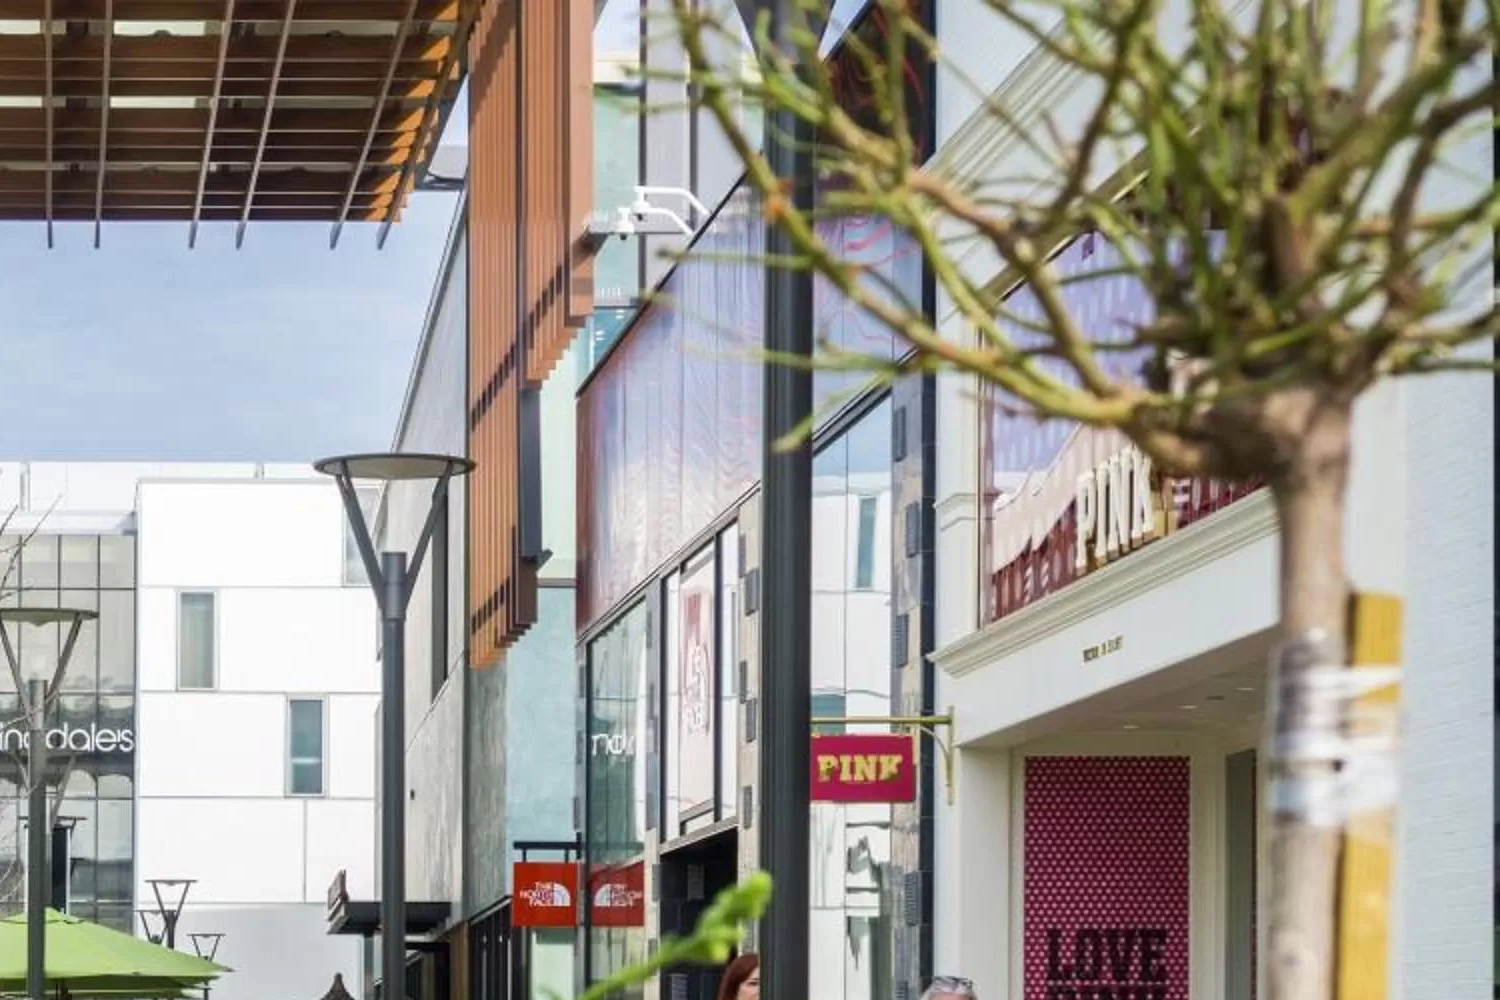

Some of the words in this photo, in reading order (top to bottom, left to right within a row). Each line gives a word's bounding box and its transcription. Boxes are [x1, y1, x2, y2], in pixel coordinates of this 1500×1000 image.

[1075, 442, 1157, 572] PINK
[817, 754, 903, 784] PINK
[1048, 928, 1167, 982] LOVE
